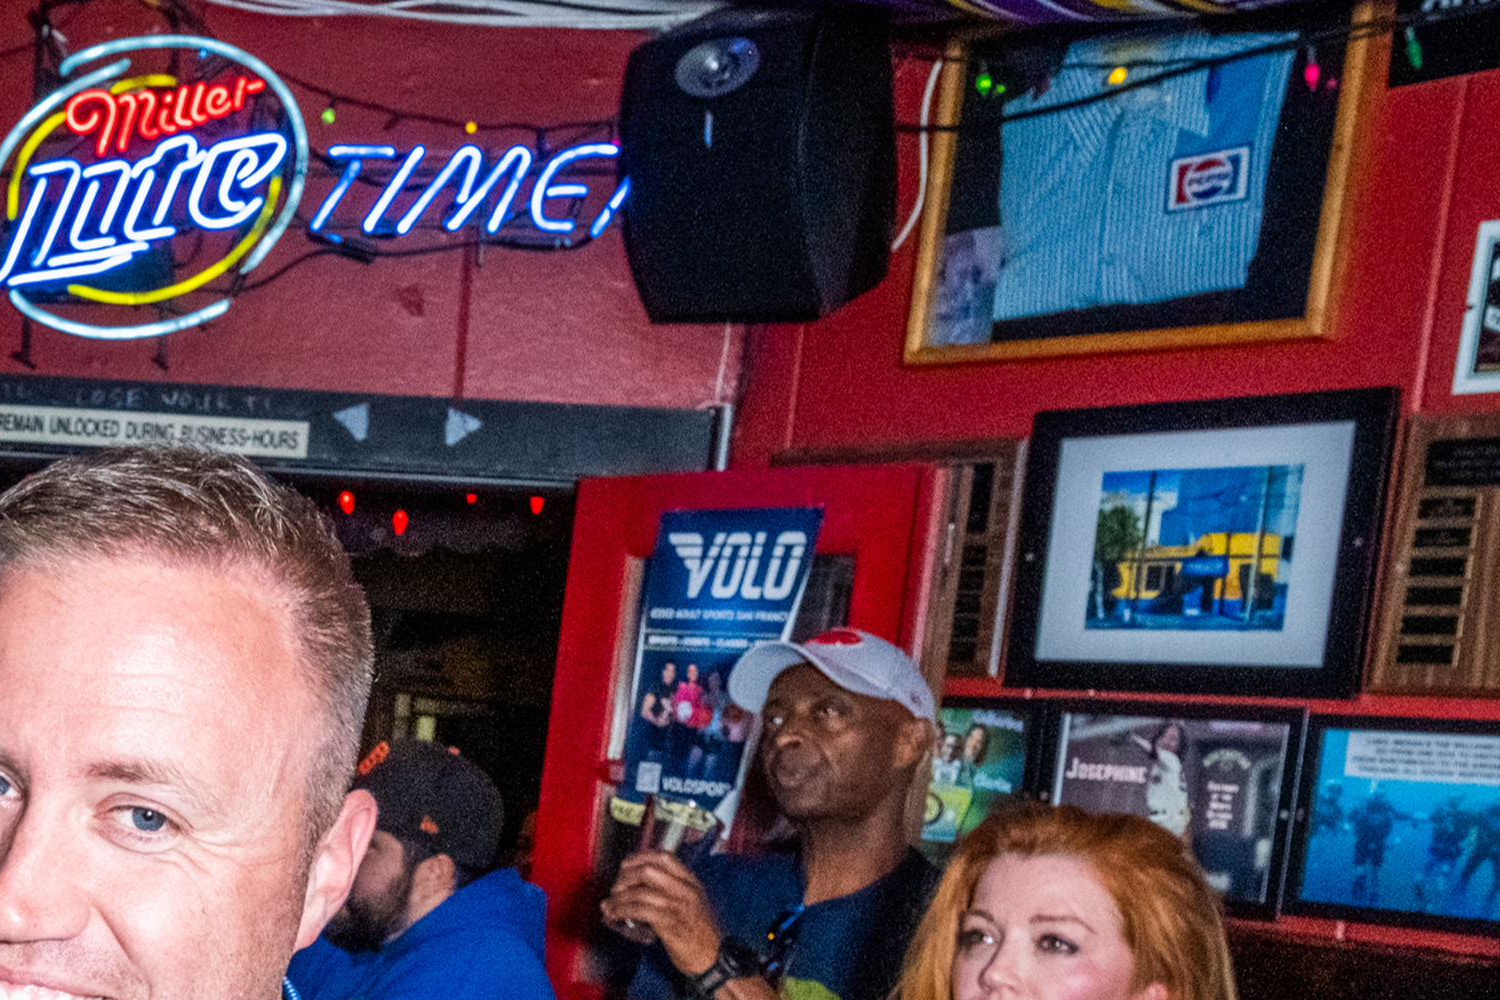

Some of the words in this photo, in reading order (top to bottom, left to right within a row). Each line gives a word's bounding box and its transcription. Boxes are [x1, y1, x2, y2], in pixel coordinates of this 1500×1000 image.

[65, 75, 266, 157] Miller
[50, 415, 120, 439] UNLOCKED
[125, 420, 174, 442] DURING
[668, 530, 808, 600] VOLO
